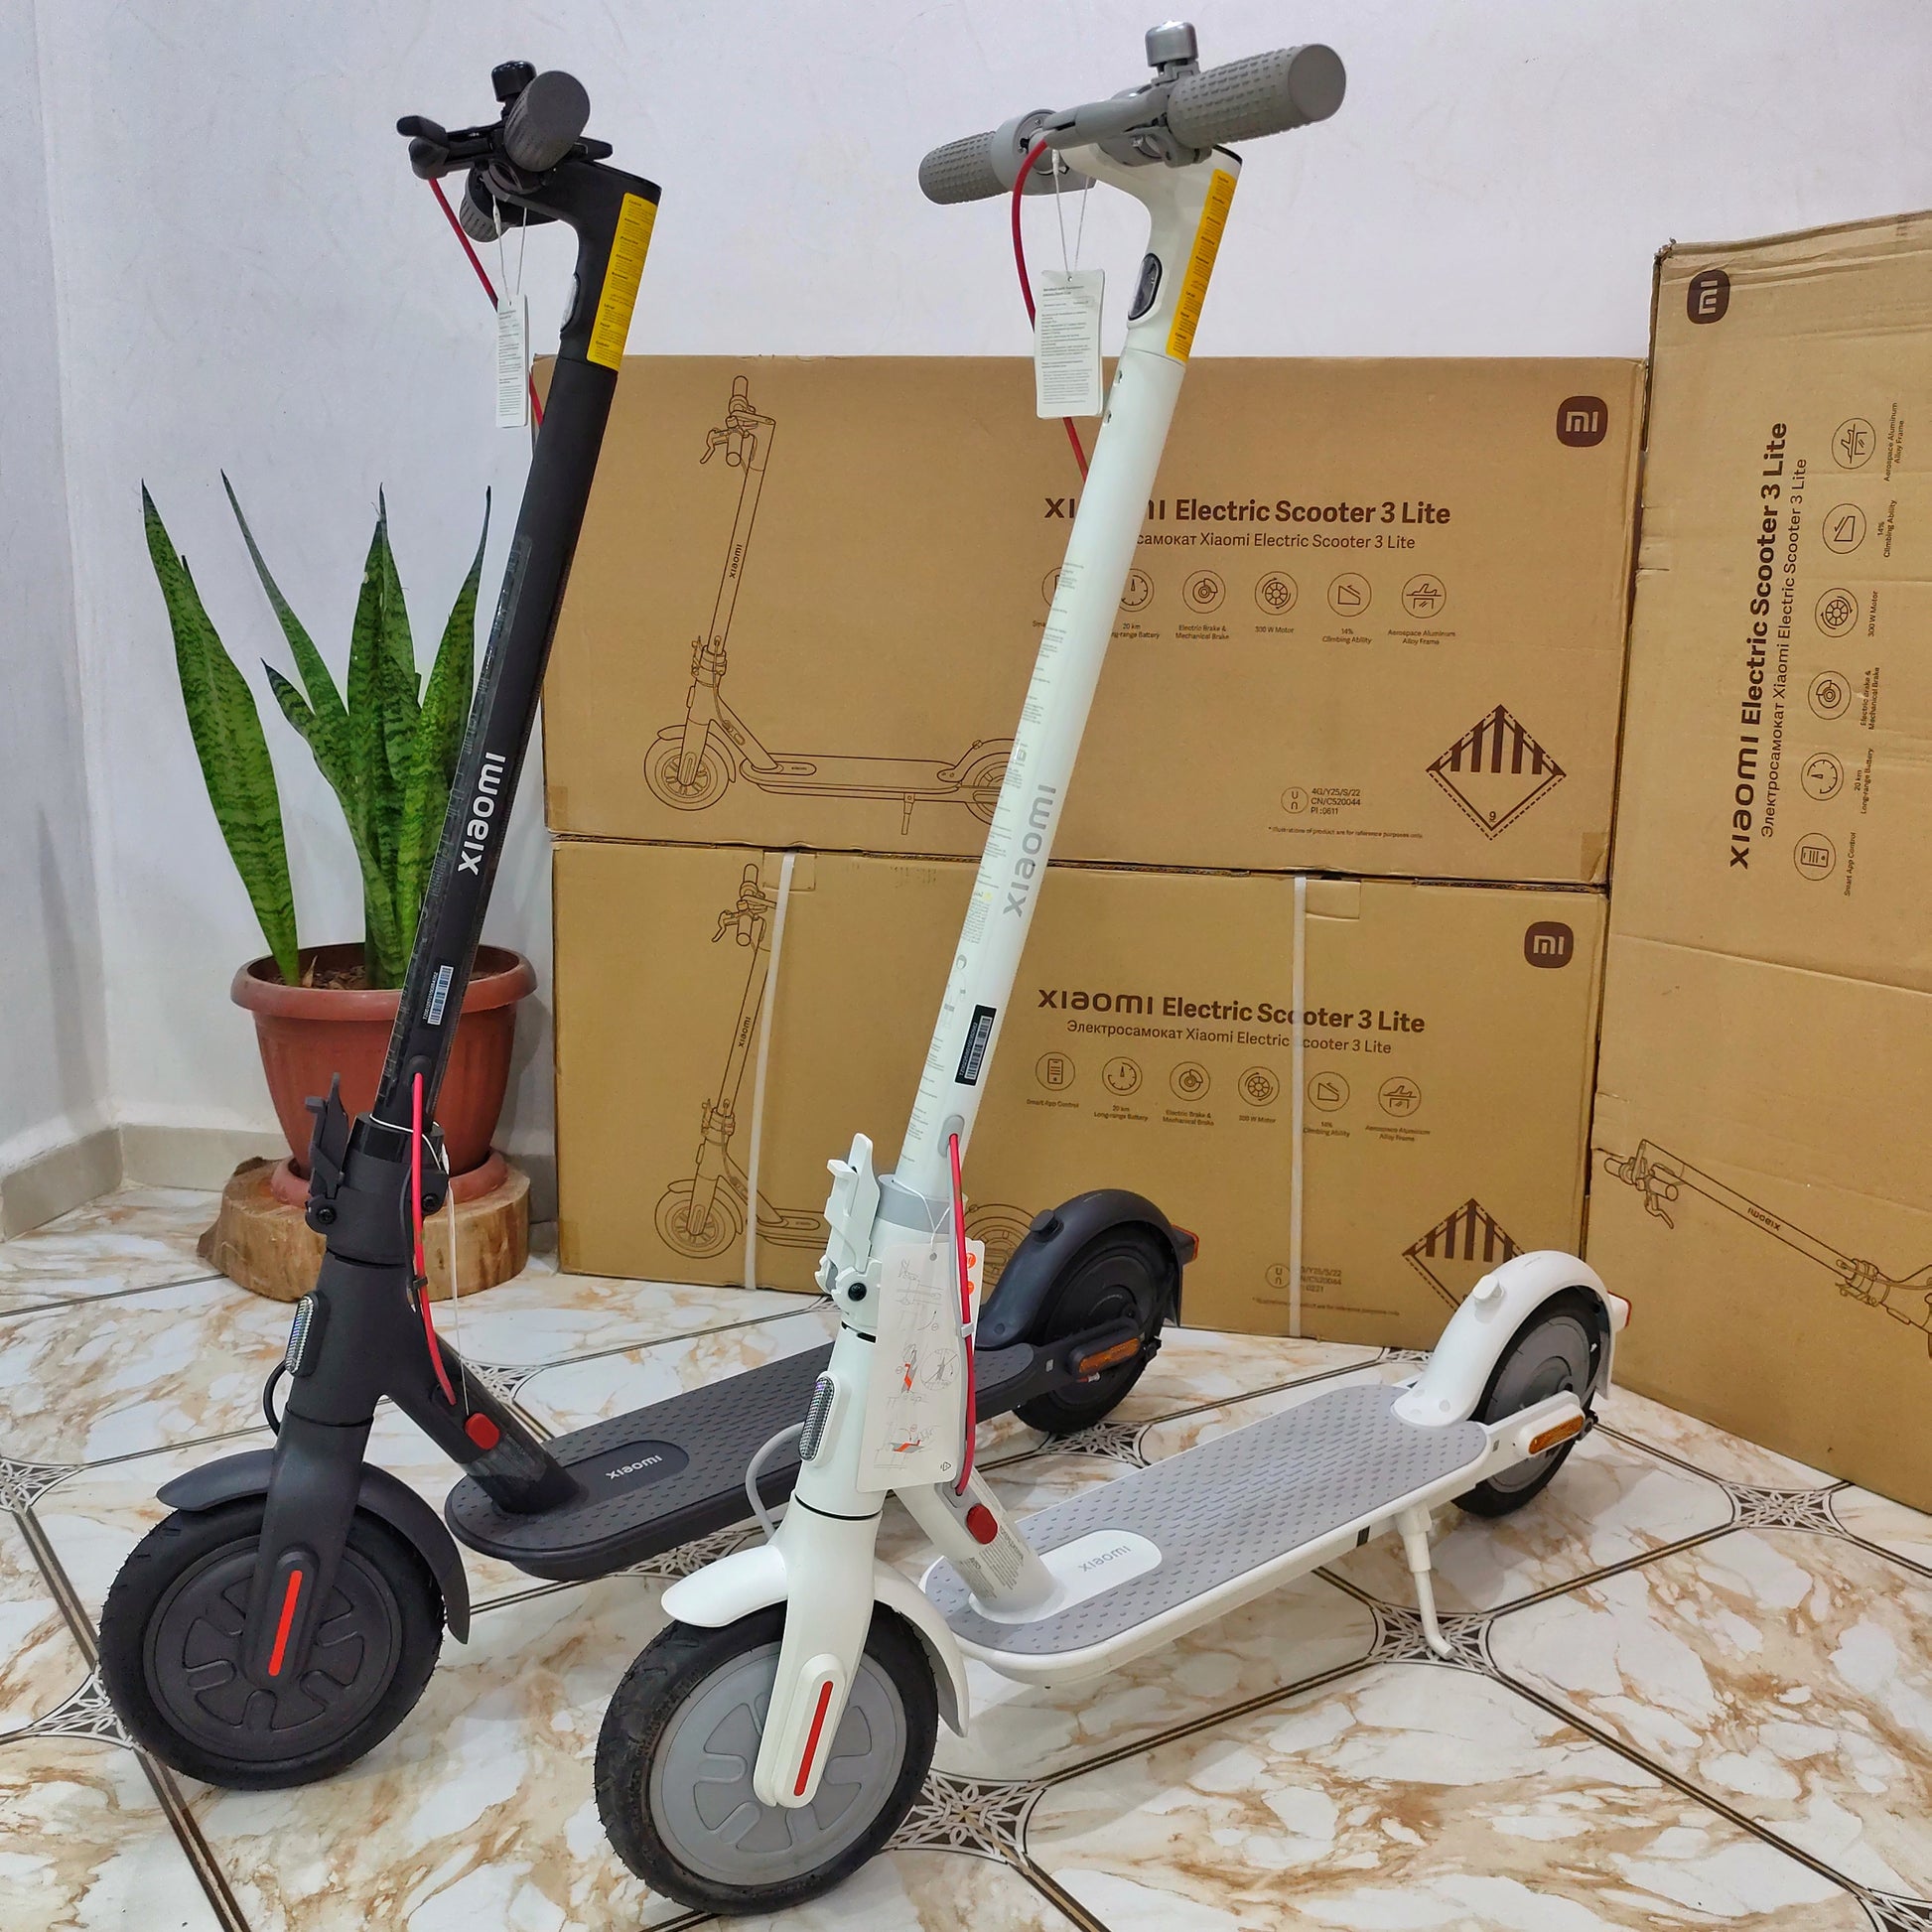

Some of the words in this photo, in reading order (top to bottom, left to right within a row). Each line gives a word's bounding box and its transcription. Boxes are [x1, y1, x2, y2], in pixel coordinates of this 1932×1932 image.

[1762, 422, 1787, 477] Lite
[1791, 459, 1807, 489] Lite
[1760, 483, 1781, 499] 3
[1790, 494, 1803, 504] 3
[1175, 498, 1270, 522] Electric
[1275, 499, 1376, 523] Scooter
[1380, 501, 1396, 524] 3
[1402, 500, 1450, 524] Lite
[1199, 532, 1250, 547] Xiaomi
[1254, 532, 1309, 547] Electric
[1311, 533, 1371, 548] Scooter
[1374, 535, 1383, 549] 3
[1388, 535, 1416, 549] Lite
[1783, 508, 1802, 574] Scooter
[729, 544, 743, 579] xiaomi
[1750, 505, 1778, 617] Scooter
[1777, 578, 1795, 639] Electric
[1869, 590, 1878, 614] Motor
[1869, 614, 1875, 623] W
[1741, 621, 1768, 725] Electric
[1772, 643, 1790, 699] Xiaomi
[1761, 702, 1785, 838] Электросамокат
[1855, 769, 1863, 781] km
[1854, 781, 1862, 791] 20
[1488, 811, 1497, 822] 9
[1846, 859, 1855, 874] App
[1163, 997, 1253, 1022] Electric
[1357, 1009, 1372, 1030] 3
[1378, 1010, 1426, 1034] Lite
[1066, 1020, 1183, 1038] Электросамокат
[1185, 1029, 1233, 1043] Xiaomi
[1237, 1031, 1290, 1047] Electric
[1303, 1037, 1349, 1050] cooter
[1352, 1039, 1360, 1052] 3
[1365, 1039, 1392, 1053] Lite
[606, 1454, 663, 1480] xiaomi
[1078, 1545, 1132, 1573] xiaomi
